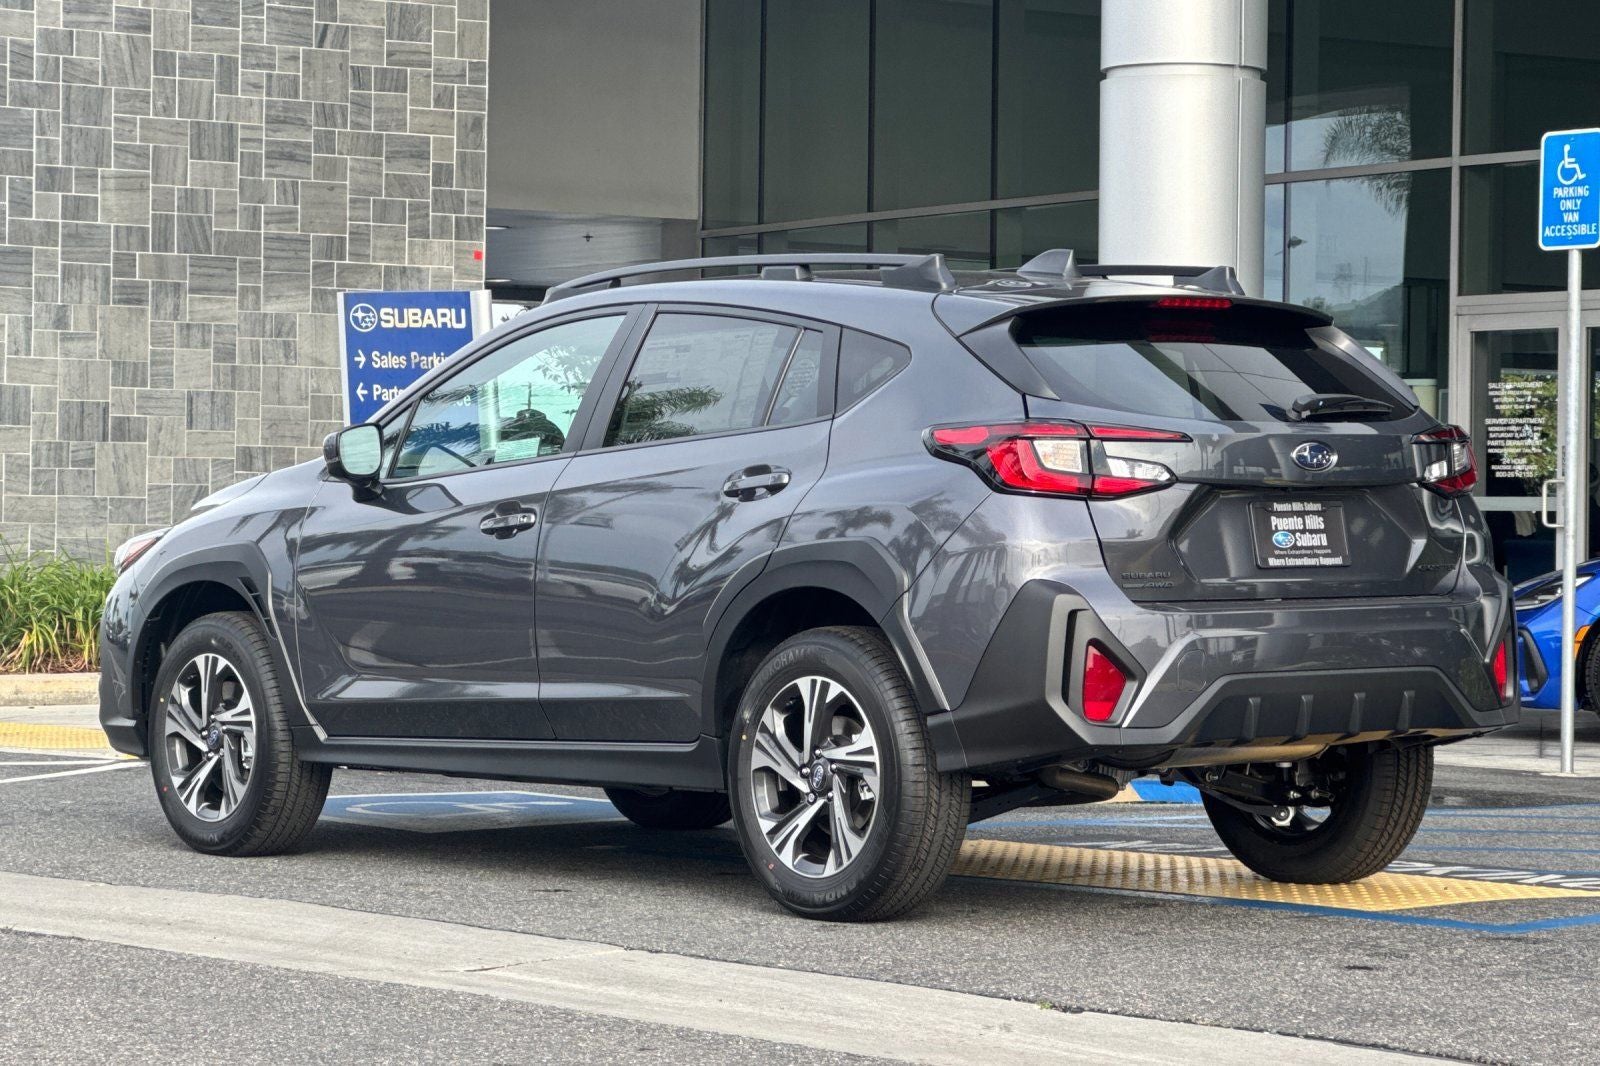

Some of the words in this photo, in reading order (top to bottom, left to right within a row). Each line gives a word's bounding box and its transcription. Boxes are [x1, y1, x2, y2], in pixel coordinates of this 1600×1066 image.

[1553, 185, 1589, 198] PARKING
[1560, 198, 1582, 211] ONLY
[1563, 211, 1579, 223] VAN
[1544, 223, 1597, 237] ACCESSIBLE
[379, 307, 467, 329] SUBARU
[371, 351, 407, 369] Sales
[410, 351, 449, 369] Parki
[1508, 417, 1545, 425] DEPARTMENT
[1273, 502, 1292, 511] Puente
[1292, 501, 1304, 511] Hills
[1304, 501, 1322, 511] Subaru
[1271, 515, 1304, 531] Puente
[1304, 514, 1325, 530] Hills
[1295, 532, 1328, 547] Subaru
[1268, 557, 1286, 566] Where
[1285, 556, 1320, 566] Extraordinary
[1120, 571, 1171, 579] SUBARU
